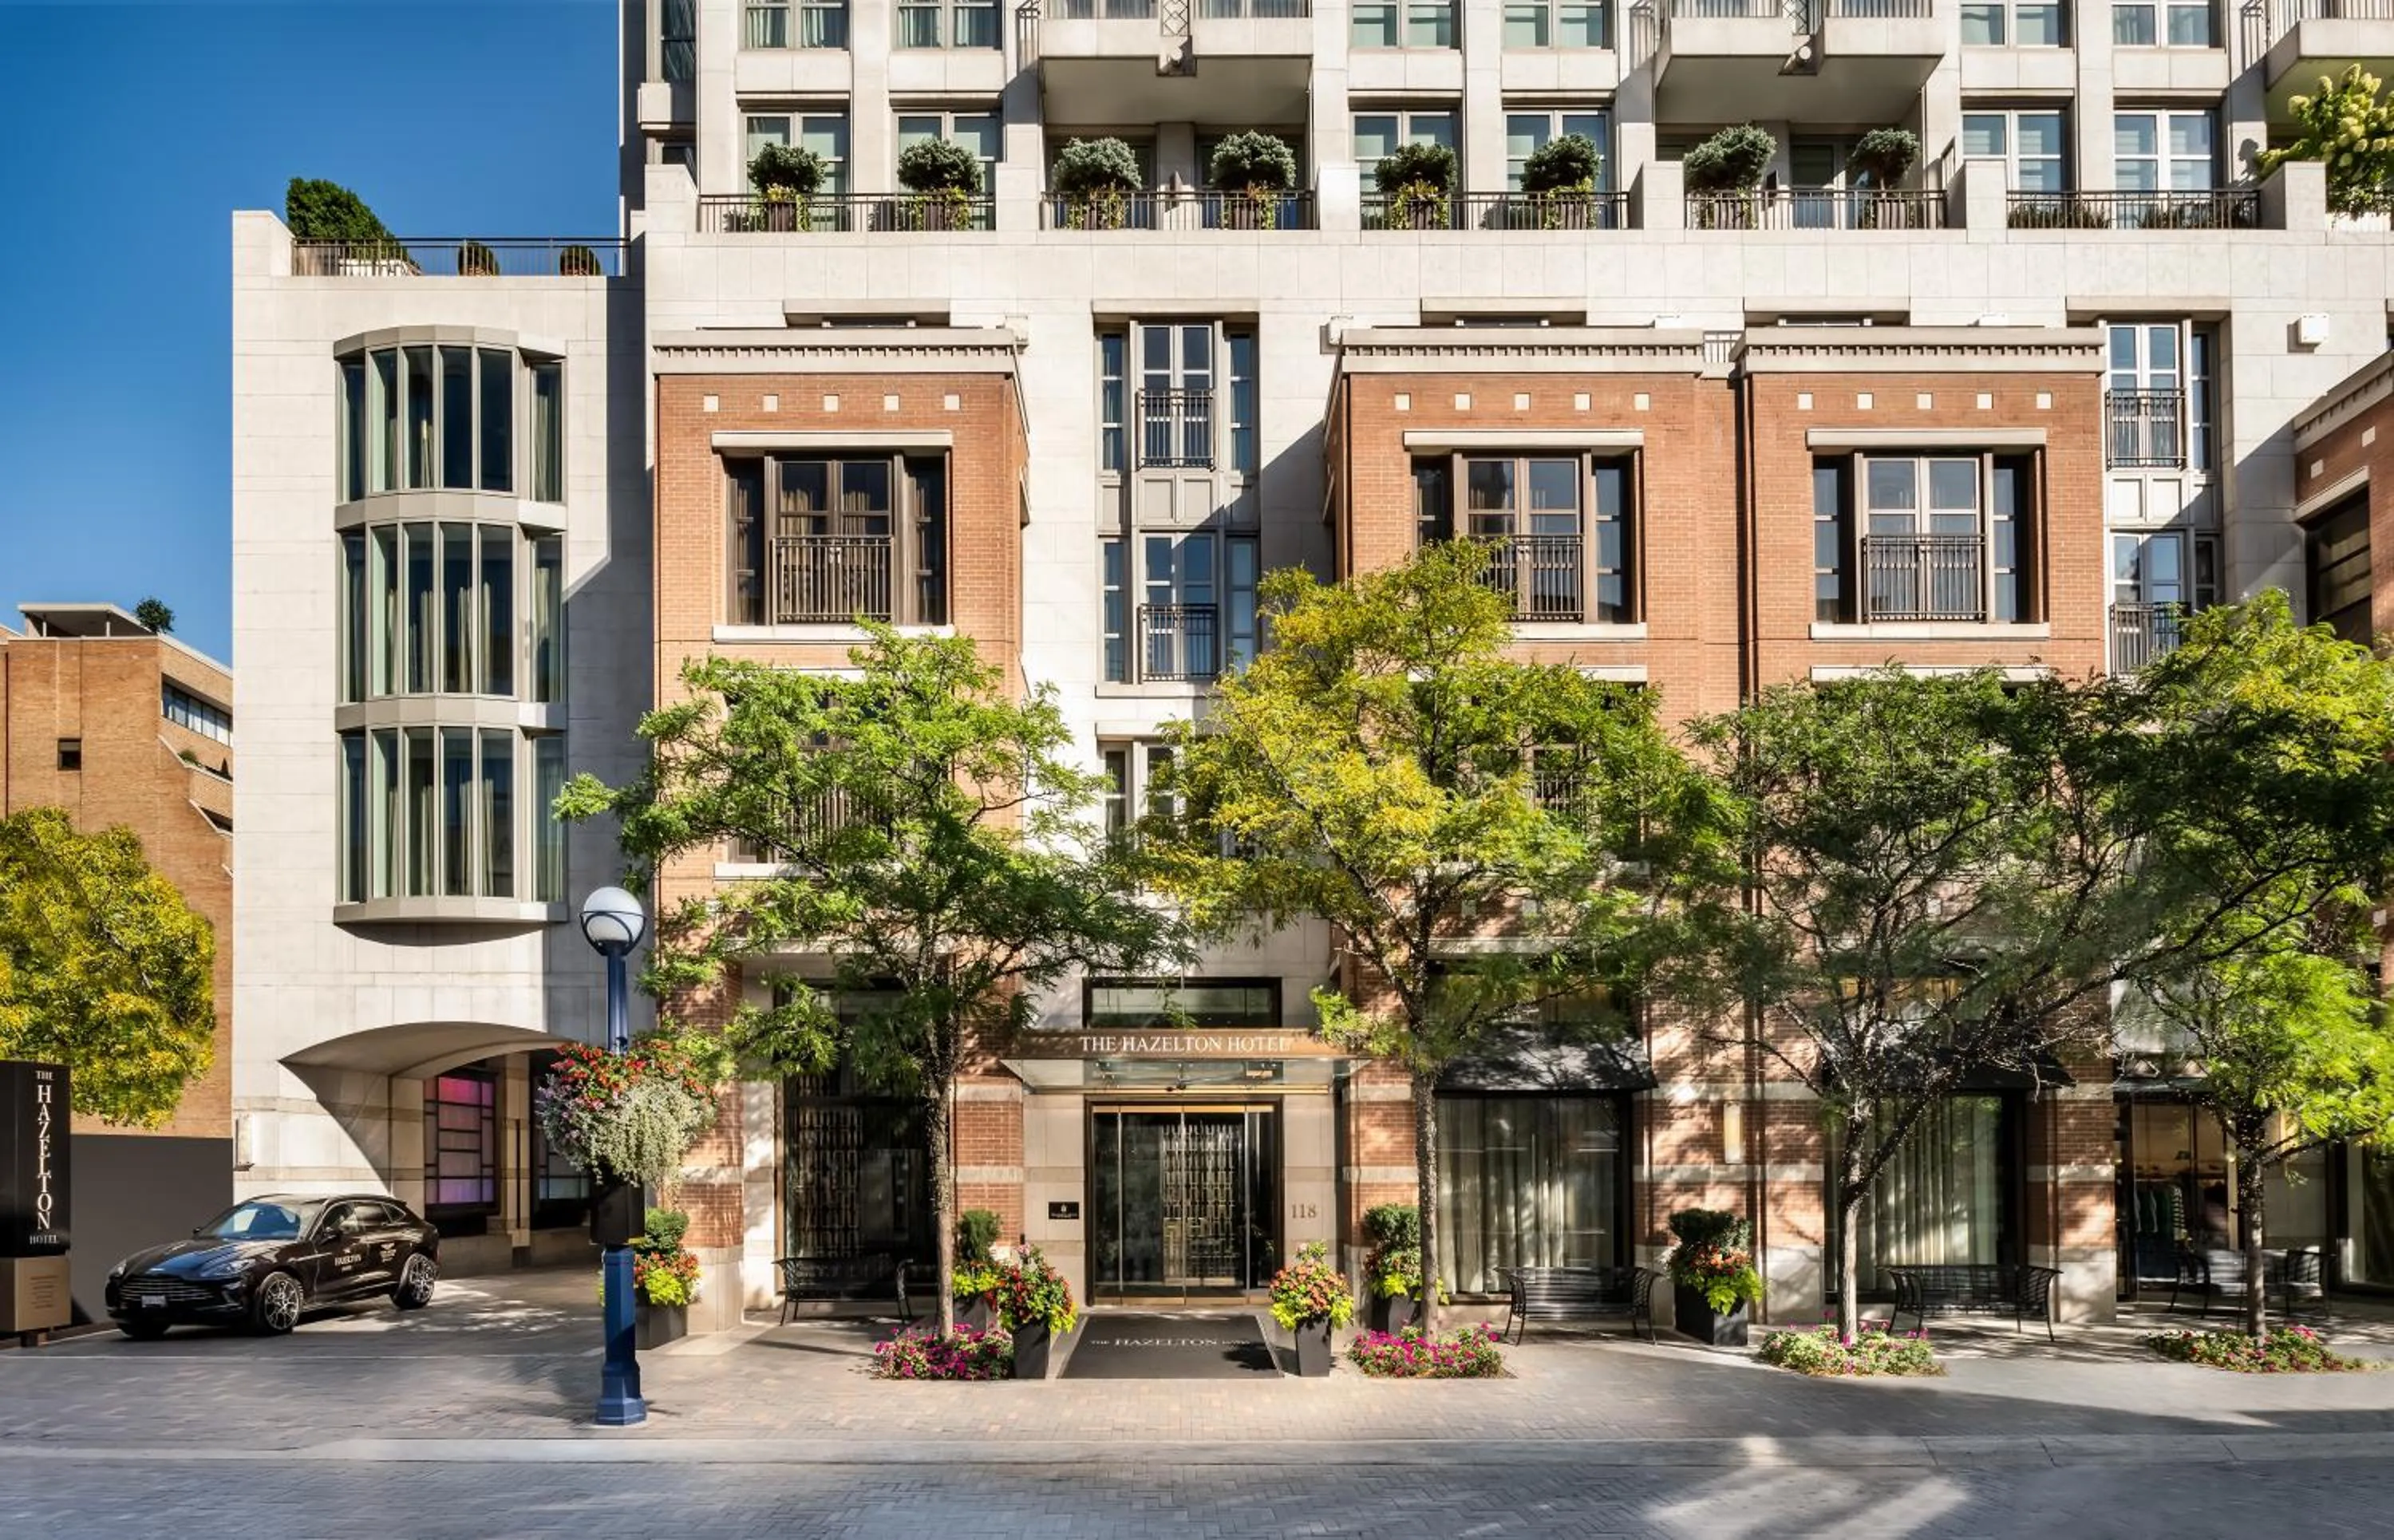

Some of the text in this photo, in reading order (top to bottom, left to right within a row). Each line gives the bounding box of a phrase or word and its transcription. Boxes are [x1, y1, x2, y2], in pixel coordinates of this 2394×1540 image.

[1079, 1036, 1290, 1052] THE HAZELTON HOTEL
[36, 1070, 54, 1080] THE
[38, 1084, 52, 1230] HAZELTON
[1292, 1203, 1316, 1218] 118
[30, 1234, 58, 1245] HOTEL
